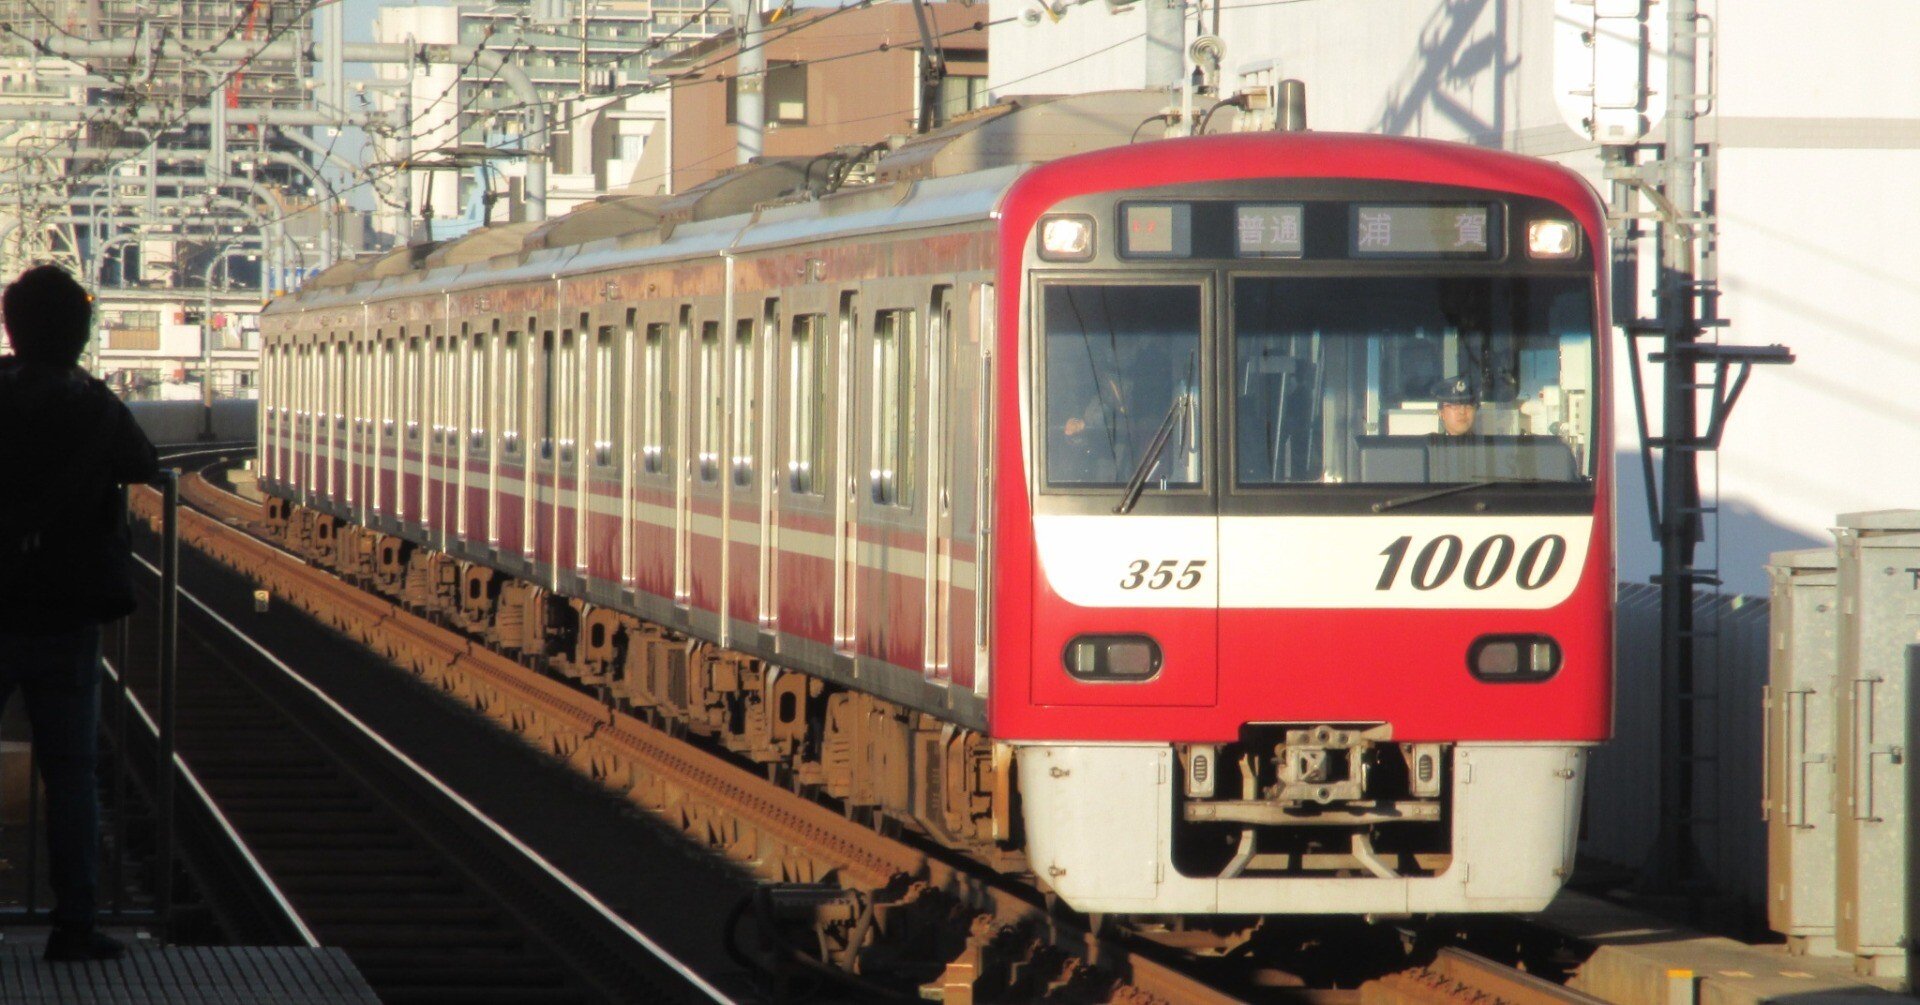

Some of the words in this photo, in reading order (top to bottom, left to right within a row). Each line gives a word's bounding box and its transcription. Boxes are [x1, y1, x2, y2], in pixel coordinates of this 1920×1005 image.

[1238, 214, 1298, 243] 普通
[1120, 559, 1207, 590] 355
[1375, 534, 1567, 591] 1000
